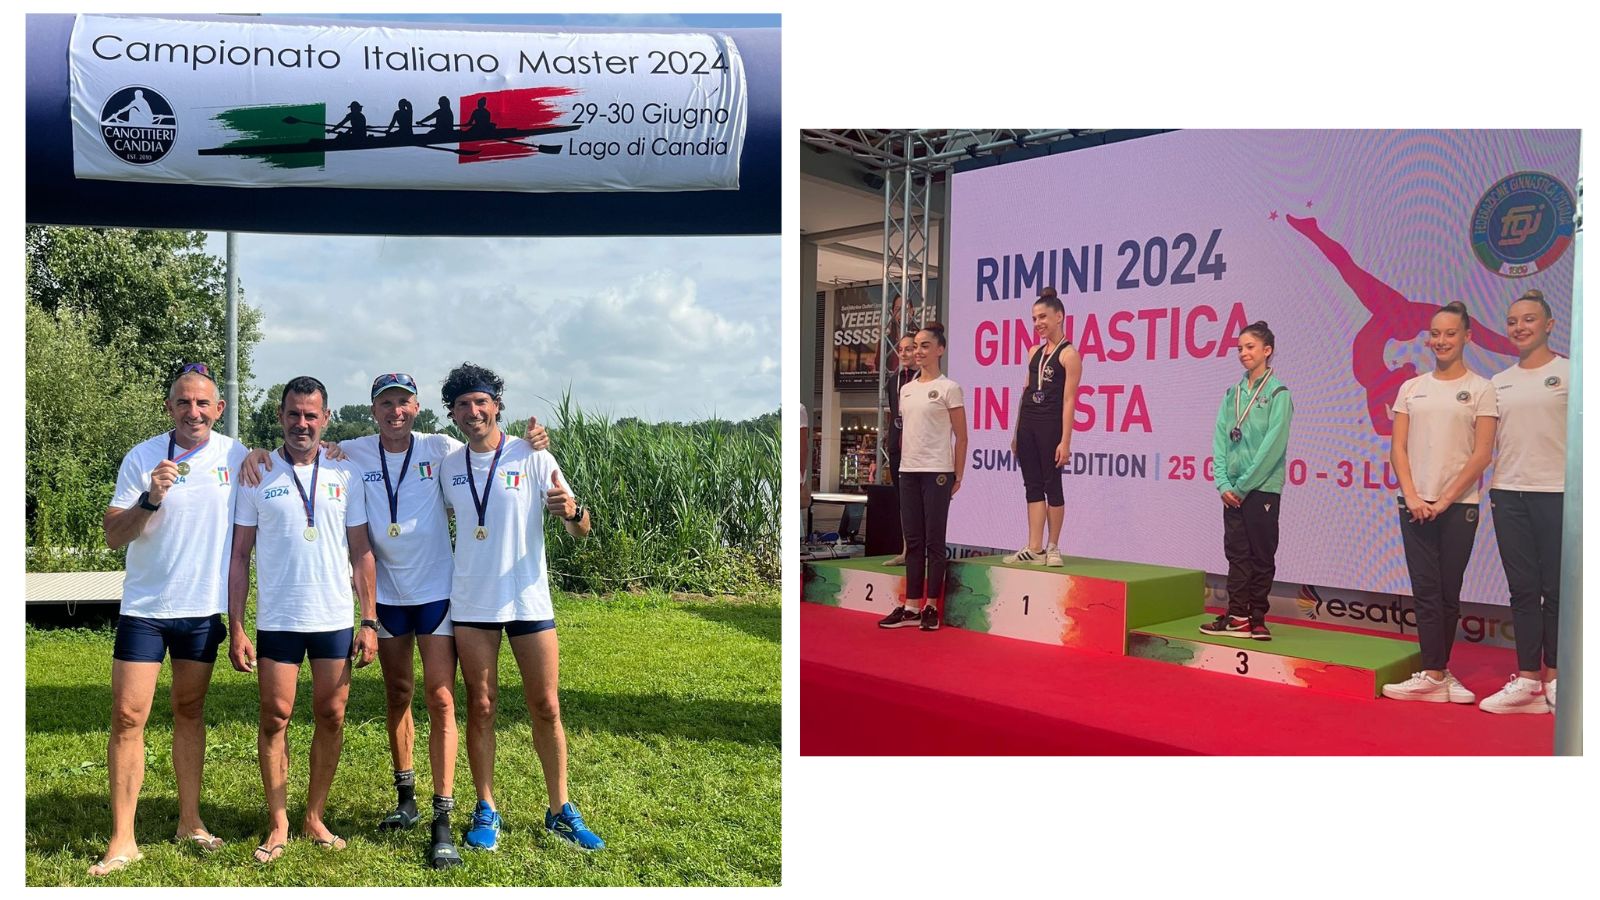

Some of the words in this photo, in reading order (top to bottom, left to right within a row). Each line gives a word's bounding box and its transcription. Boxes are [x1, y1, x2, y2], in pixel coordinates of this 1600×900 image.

[92, 34, 341, 71] Campionato
[364, 45, 499, 74] Italiano
[518, 50, 639, 75] Master
[648, 49, 729, 76] 2024
[571, 102, 635, 125] 29-30
[642, 102, 729, 130] Giugno
[104, 126, 174, 141] CANOTTIERI
[114, 139, 164, 153] CANDIA
[568, 137, 620, 160] Lago
[627, 136, 647, 156] di
[651, 136, 729, 156] Candia
[975, 243, 1103, 303] RIMINI
[1115, 228, 1228, 290] 2024
[974, 302, 1249, 367] GINASTICA
[972, 386, 1010, 431] IN
[1072, 384, 1153, 433] STA
[174, 475, 186, 485] 24
[971, 448, 1022, 473] SUM
[1167, 455, 1196, 481] 25
[1336, 460, 1354, 488] 3
[264, 487, 290, 500] 2024
[865, 583, 874, 602] 2
[1021, 594, 1030, 616] 1
[1235, 650, 1250, 675] 3
